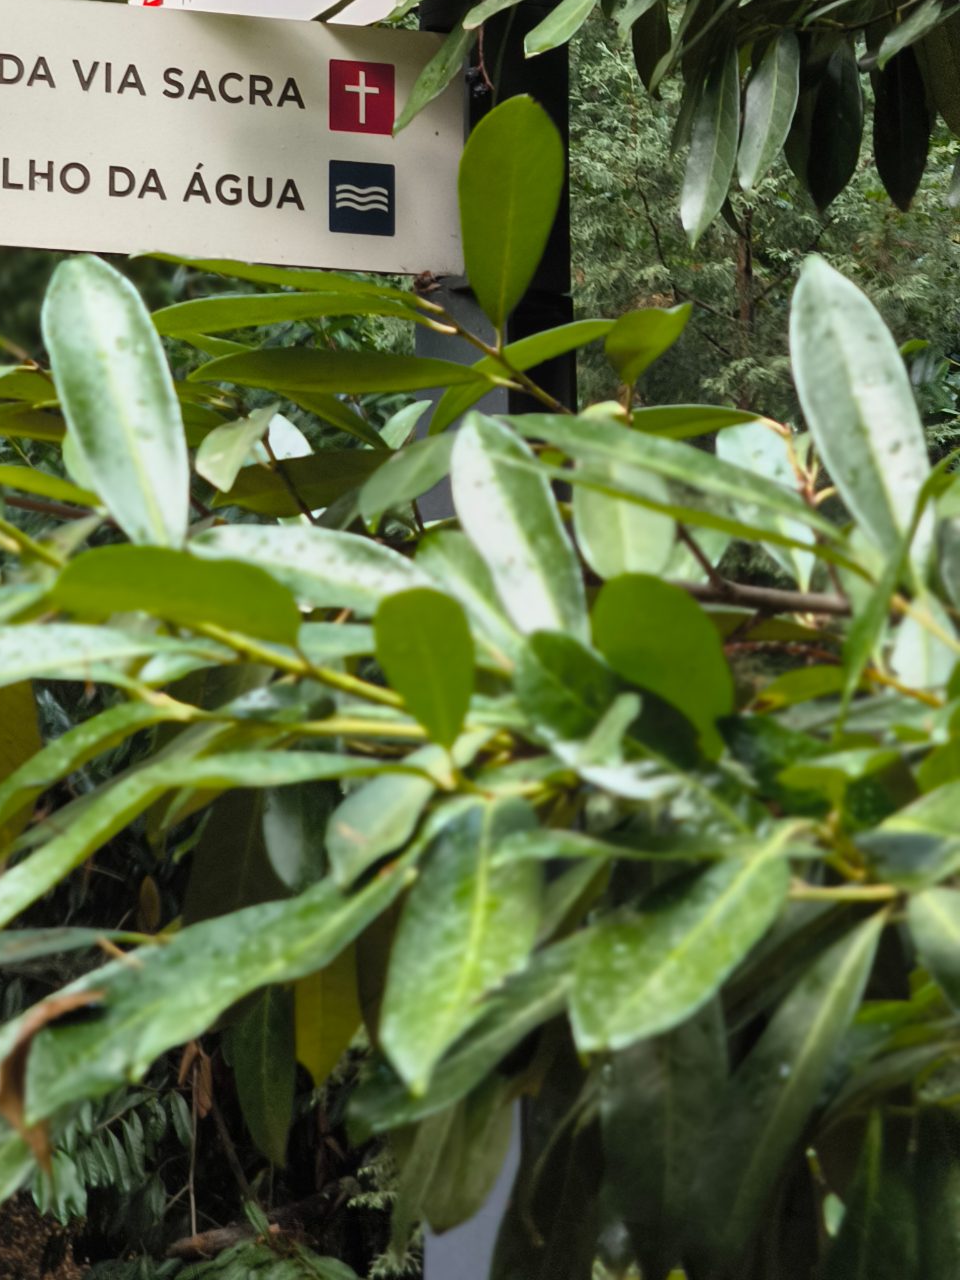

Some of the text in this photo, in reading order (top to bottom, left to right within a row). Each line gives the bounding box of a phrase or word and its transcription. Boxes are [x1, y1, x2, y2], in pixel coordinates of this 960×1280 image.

[72, 59, 147, 96] VIA
[162, 67, 307, 110] SACRA
[108, 165, 167, 201] DA
[182, 162, 305, 212] ÁGUA
